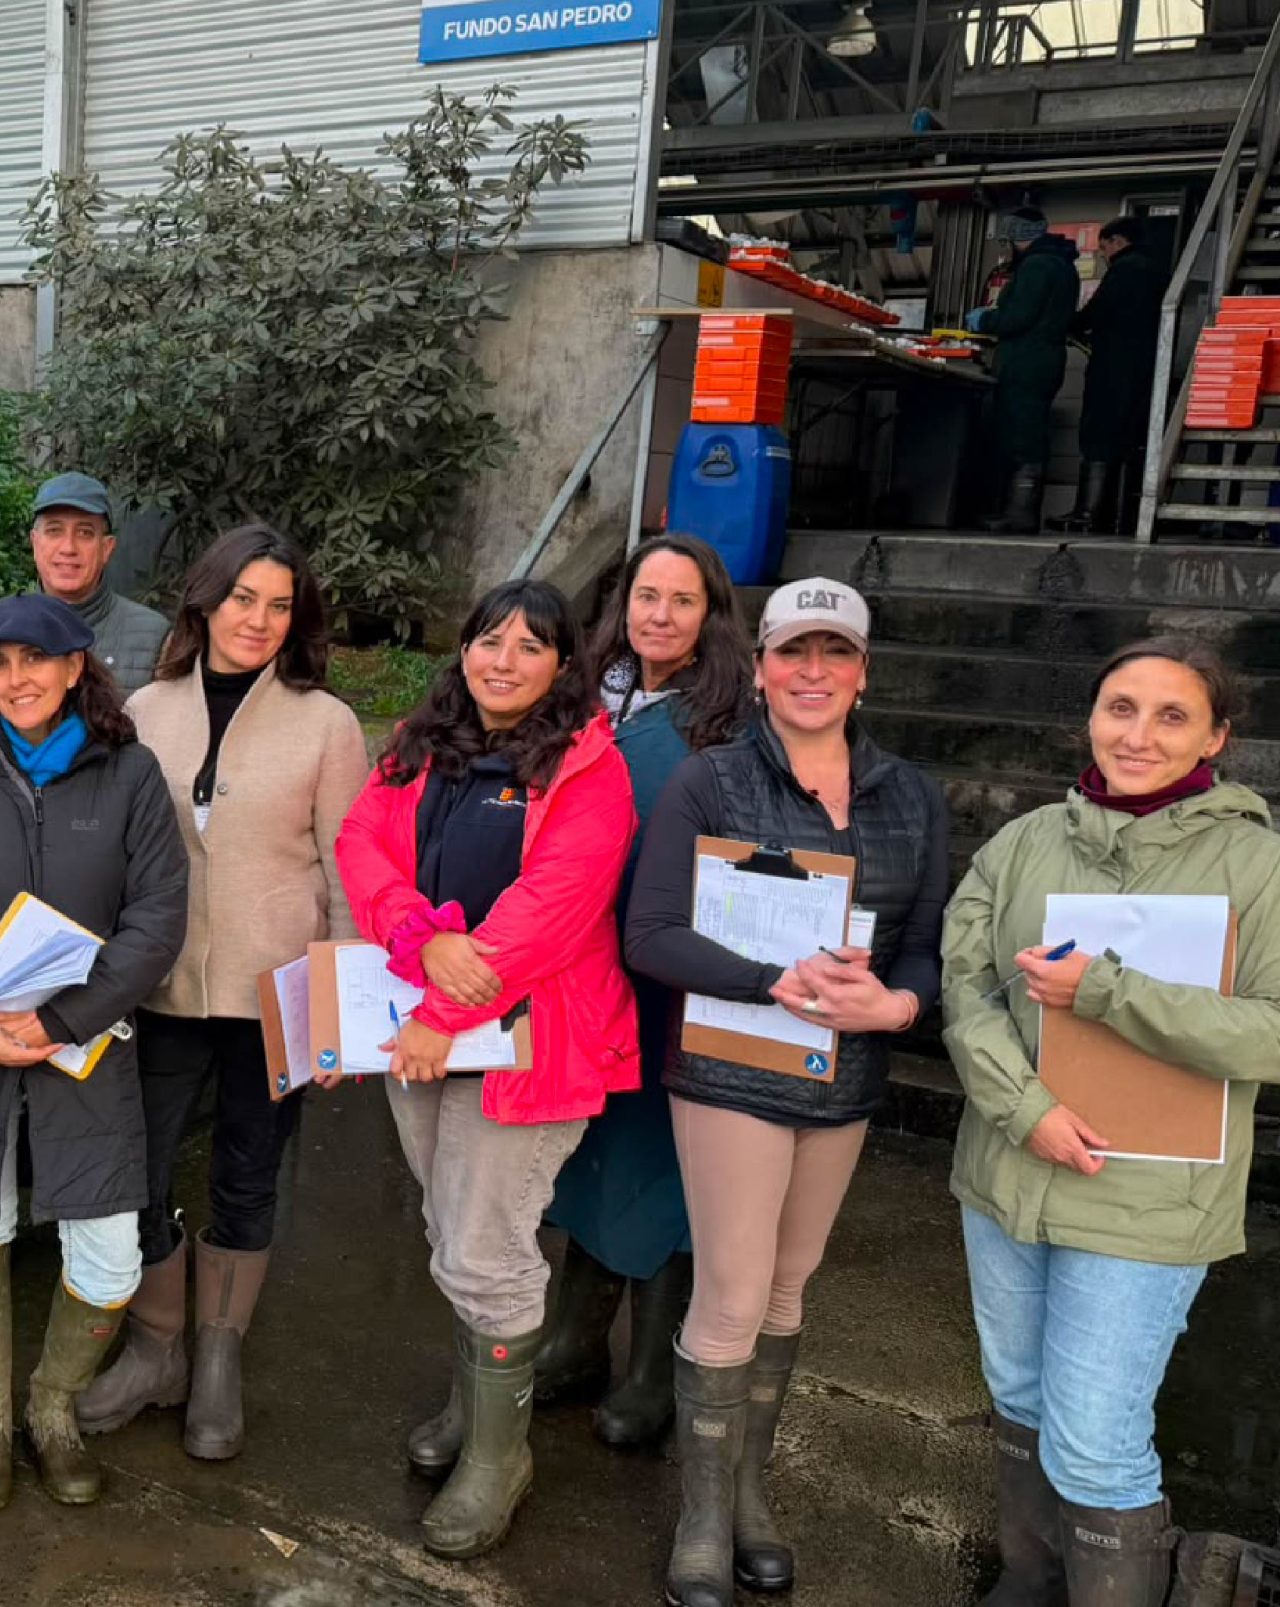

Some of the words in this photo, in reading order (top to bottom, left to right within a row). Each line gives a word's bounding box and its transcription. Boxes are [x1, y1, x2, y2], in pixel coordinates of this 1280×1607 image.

[444, 15, 512, 40] FUNDO
[514, 11, 558, 32] SAN
[560, 2, 632, 28] PEDRO
[797, 589, 839, 611] CAT
